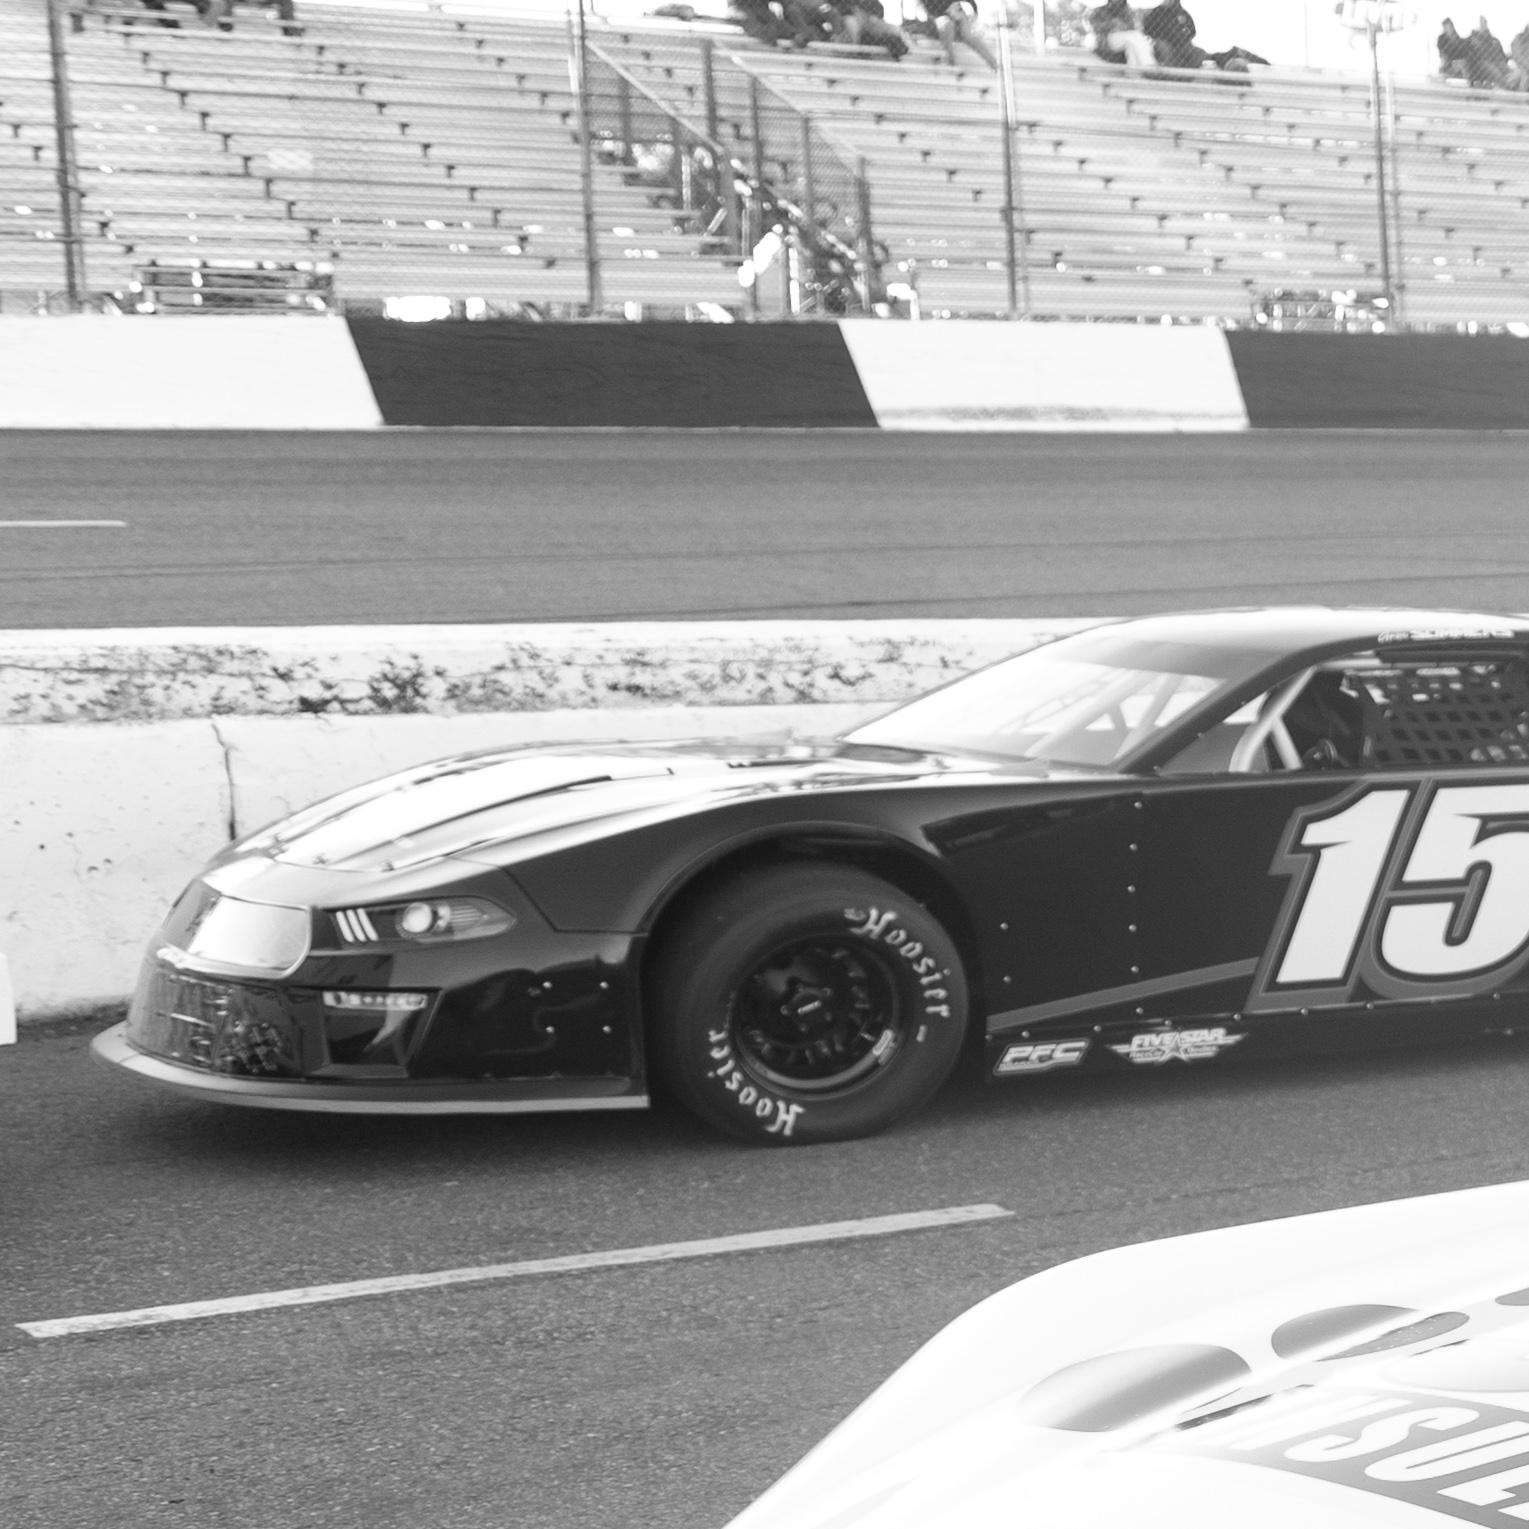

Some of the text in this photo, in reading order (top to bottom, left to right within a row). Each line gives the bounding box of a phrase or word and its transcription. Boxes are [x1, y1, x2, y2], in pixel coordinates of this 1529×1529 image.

[850, 906, 950, 1018] Hoosier
[1002, 1040, 1087, 1063] PFC
[1131, 1027, 1227, 1049] FIVE STAR
[708, 1028, 805, 1136] Hoosier
